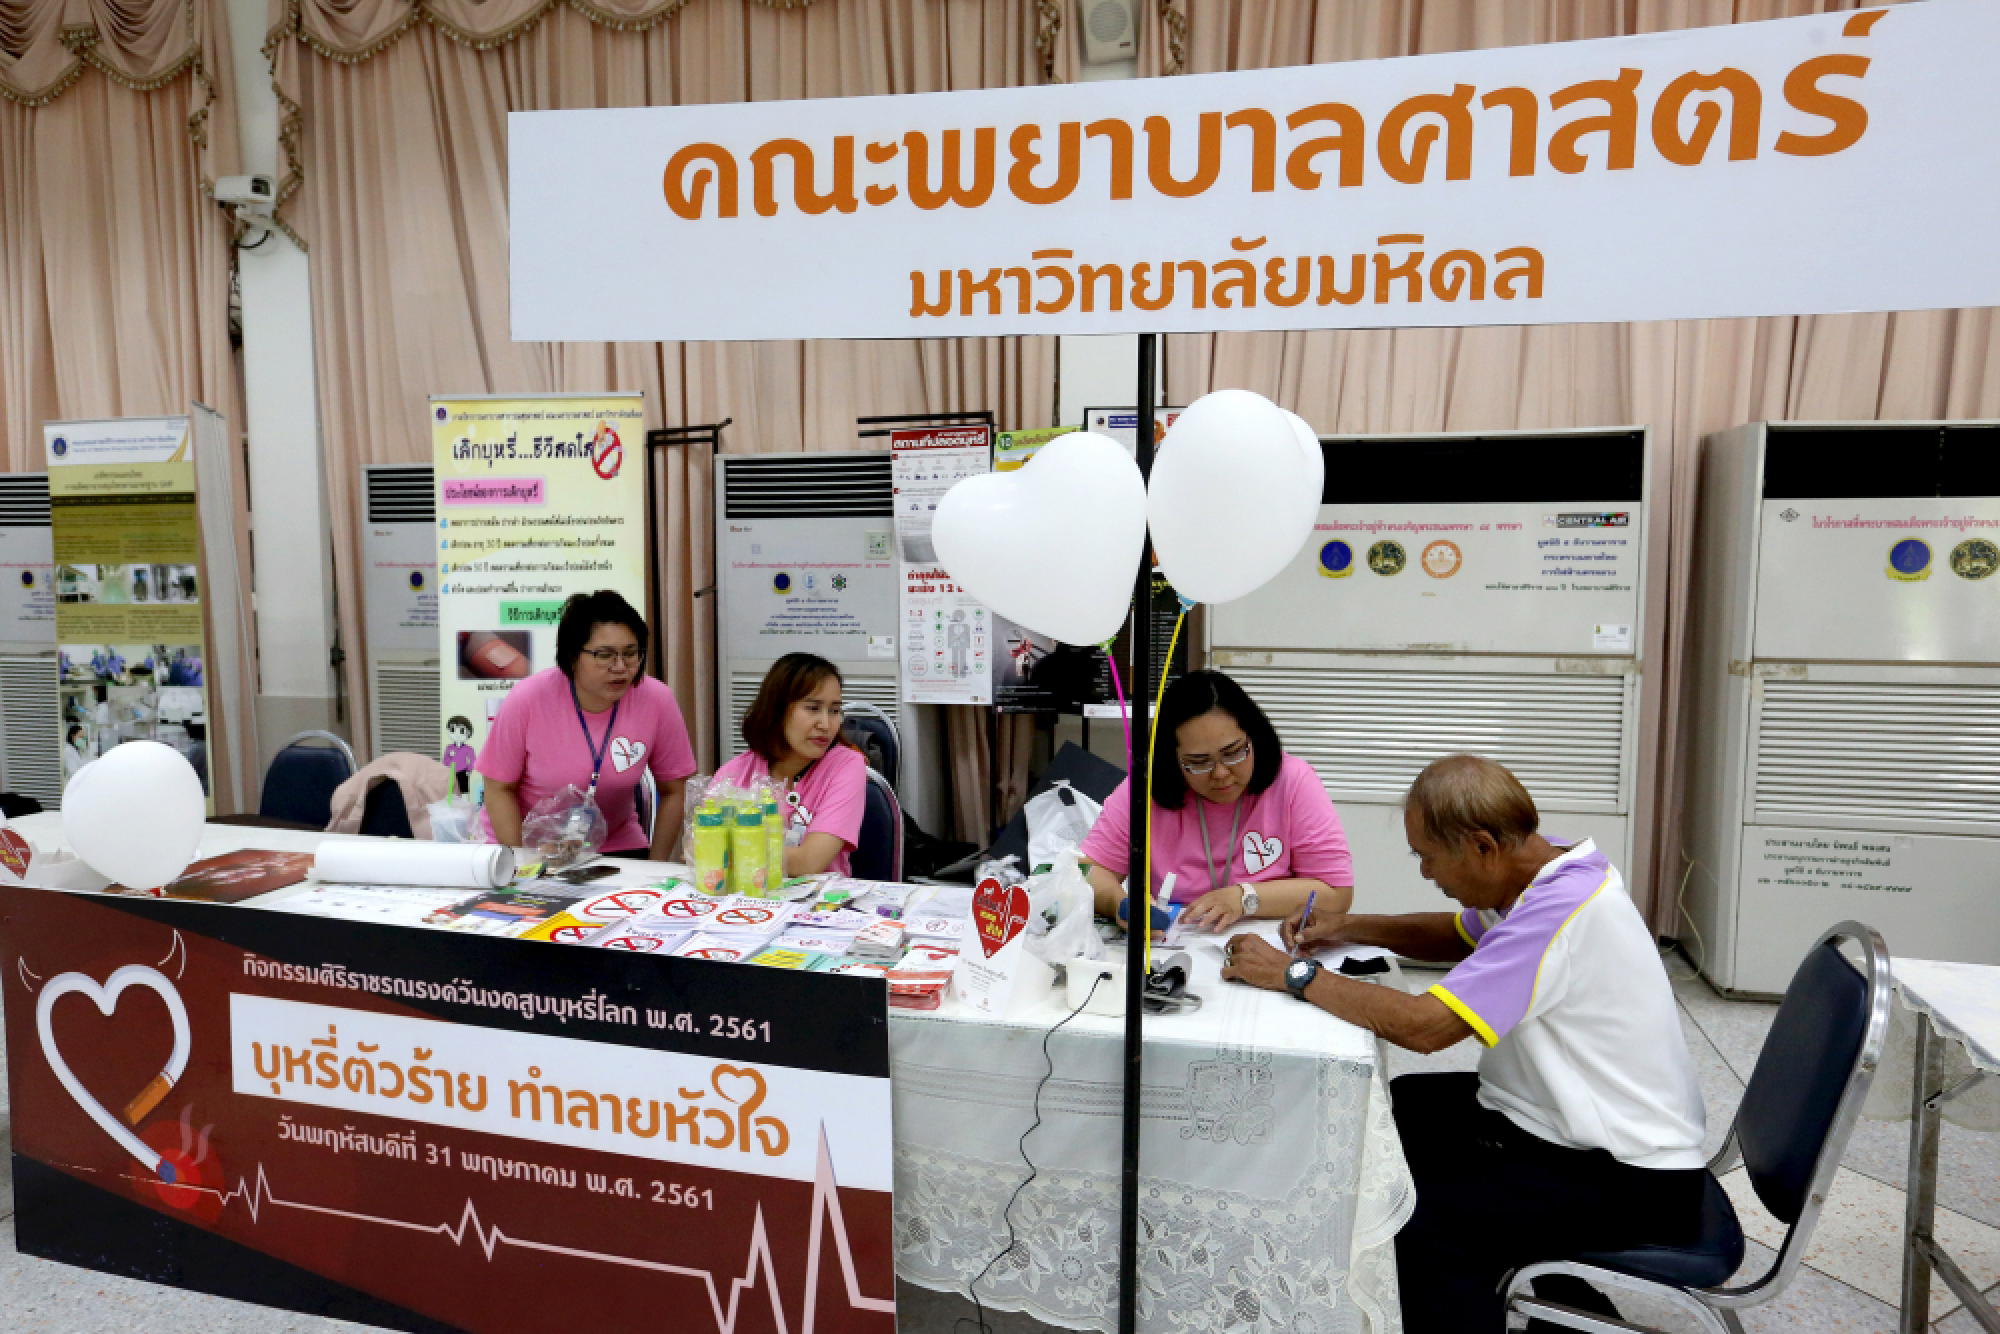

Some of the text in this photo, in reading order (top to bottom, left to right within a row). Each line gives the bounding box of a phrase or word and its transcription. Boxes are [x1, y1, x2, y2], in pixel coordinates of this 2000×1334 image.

[664, 10, 1888, 220] คณะพยาบาลศาสตร์
[910, 234, 1544, 316] มหาวิทยาลัยมหิดล
[243, 953, 772, 1043] กิจกรรมศิริราชรณรงค์วันงดสูบบุหรี่โลก พ.ศ. 2561
[252, 1025, 790, 1157] บุหรี่ตัวร้าย ทำลายหัวใจ
[278, 1114, 714, 1211] วันพฤหัสบดีที่ 31 พฤษภาคม พ.ศ. 2561
